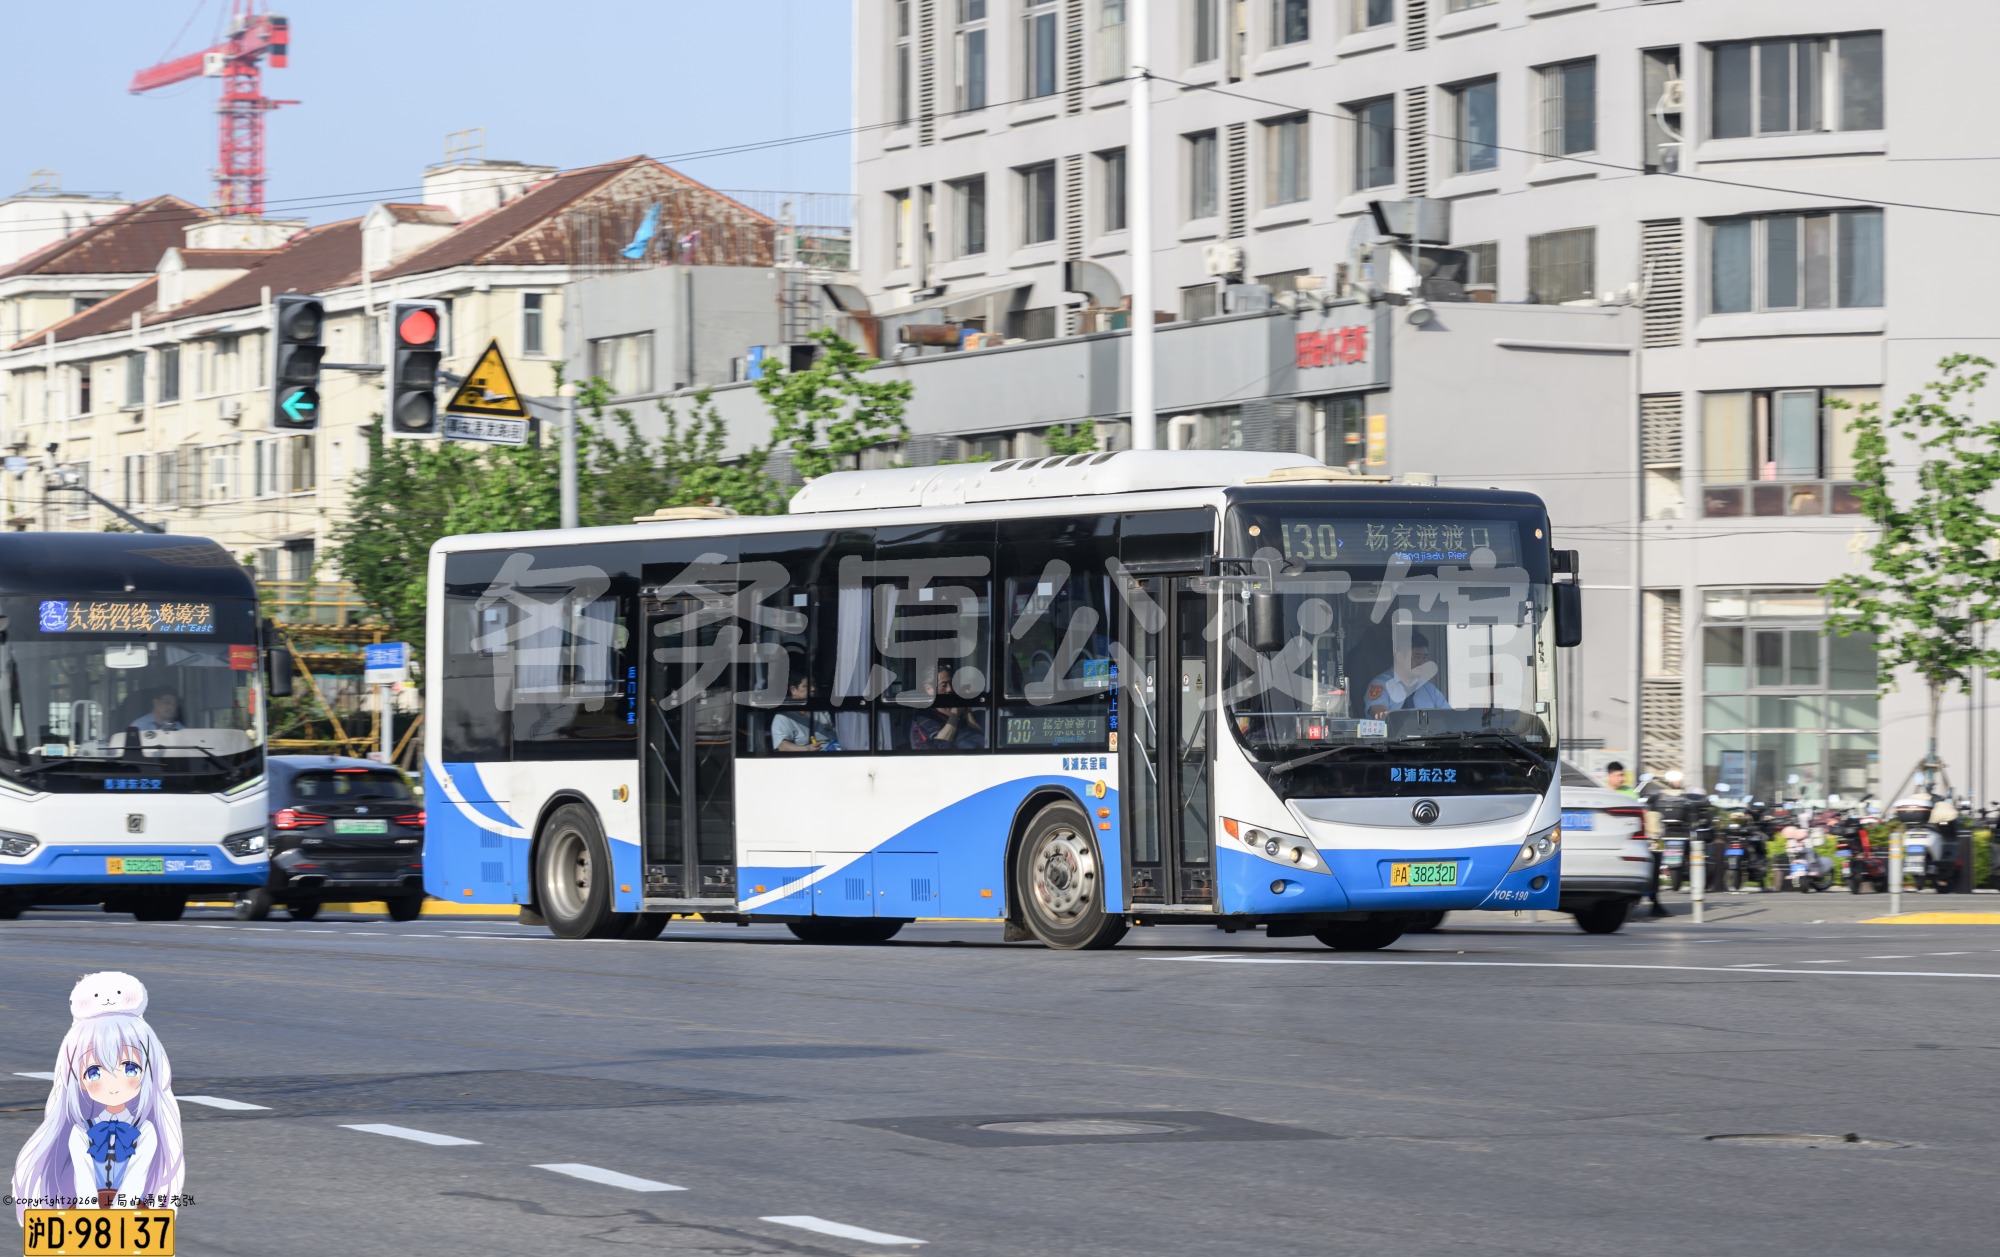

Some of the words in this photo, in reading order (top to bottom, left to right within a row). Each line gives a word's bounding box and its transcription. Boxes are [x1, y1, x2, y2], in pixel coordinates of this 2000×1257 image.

[1281, 524, 1338, 560] 130
[1365, 523, 1490, 551] 杨家渡渡口
[1395, 551, 1445, 562] Yangjiadu
[1447, 551, 1467, 560] Pier
[67, 602, 152, 631] 大桥四线
[1109, 664, 1118, 729] 前门上客
[1404, 768, 1457, 782] 浦东公交
